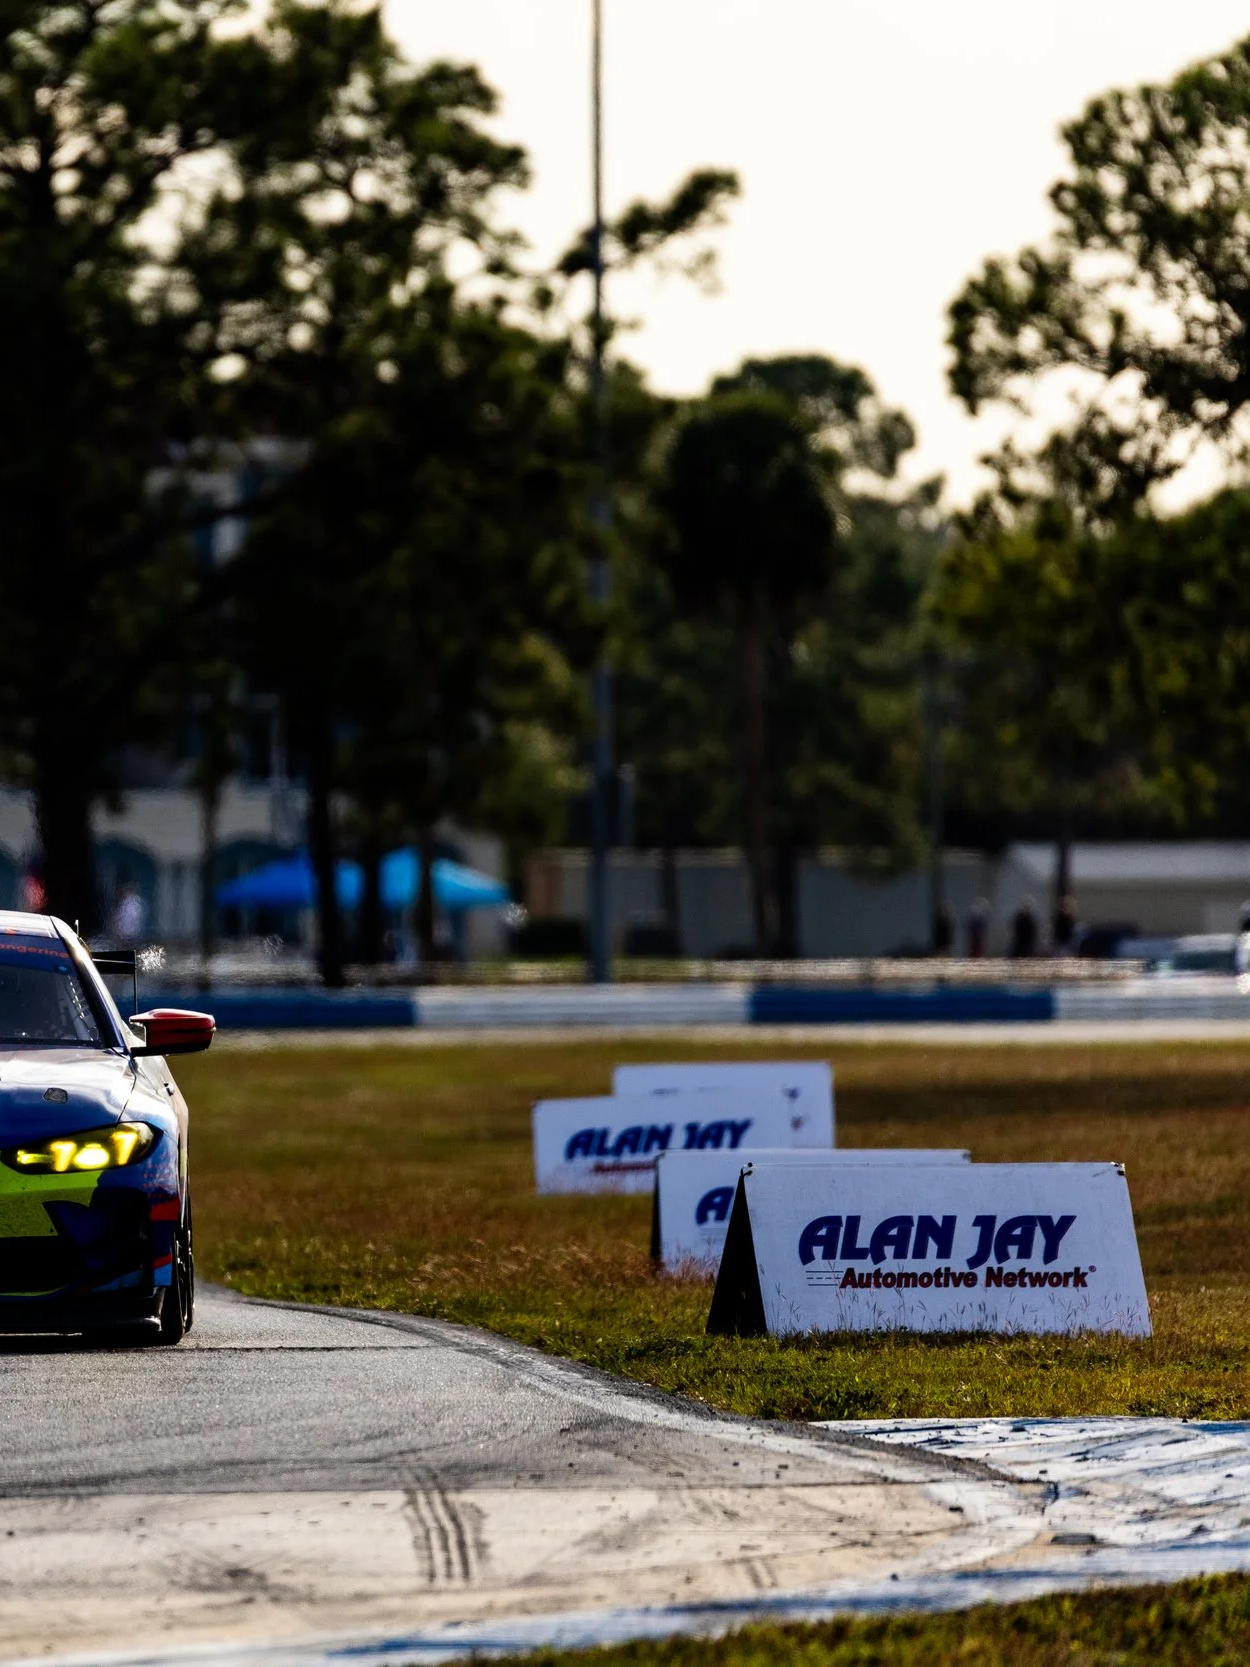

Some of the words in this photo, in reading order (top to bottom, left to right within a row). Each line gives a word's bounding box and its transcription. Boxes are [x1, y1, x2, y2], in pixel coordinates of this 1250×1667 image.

[565, 1123, 673, 1161] ALAN
[798, 1214, 957, 1266] ALAN
[966, 1214, 1076, 1270] JAY
[839, 1267, 978, 1289] Automotive
